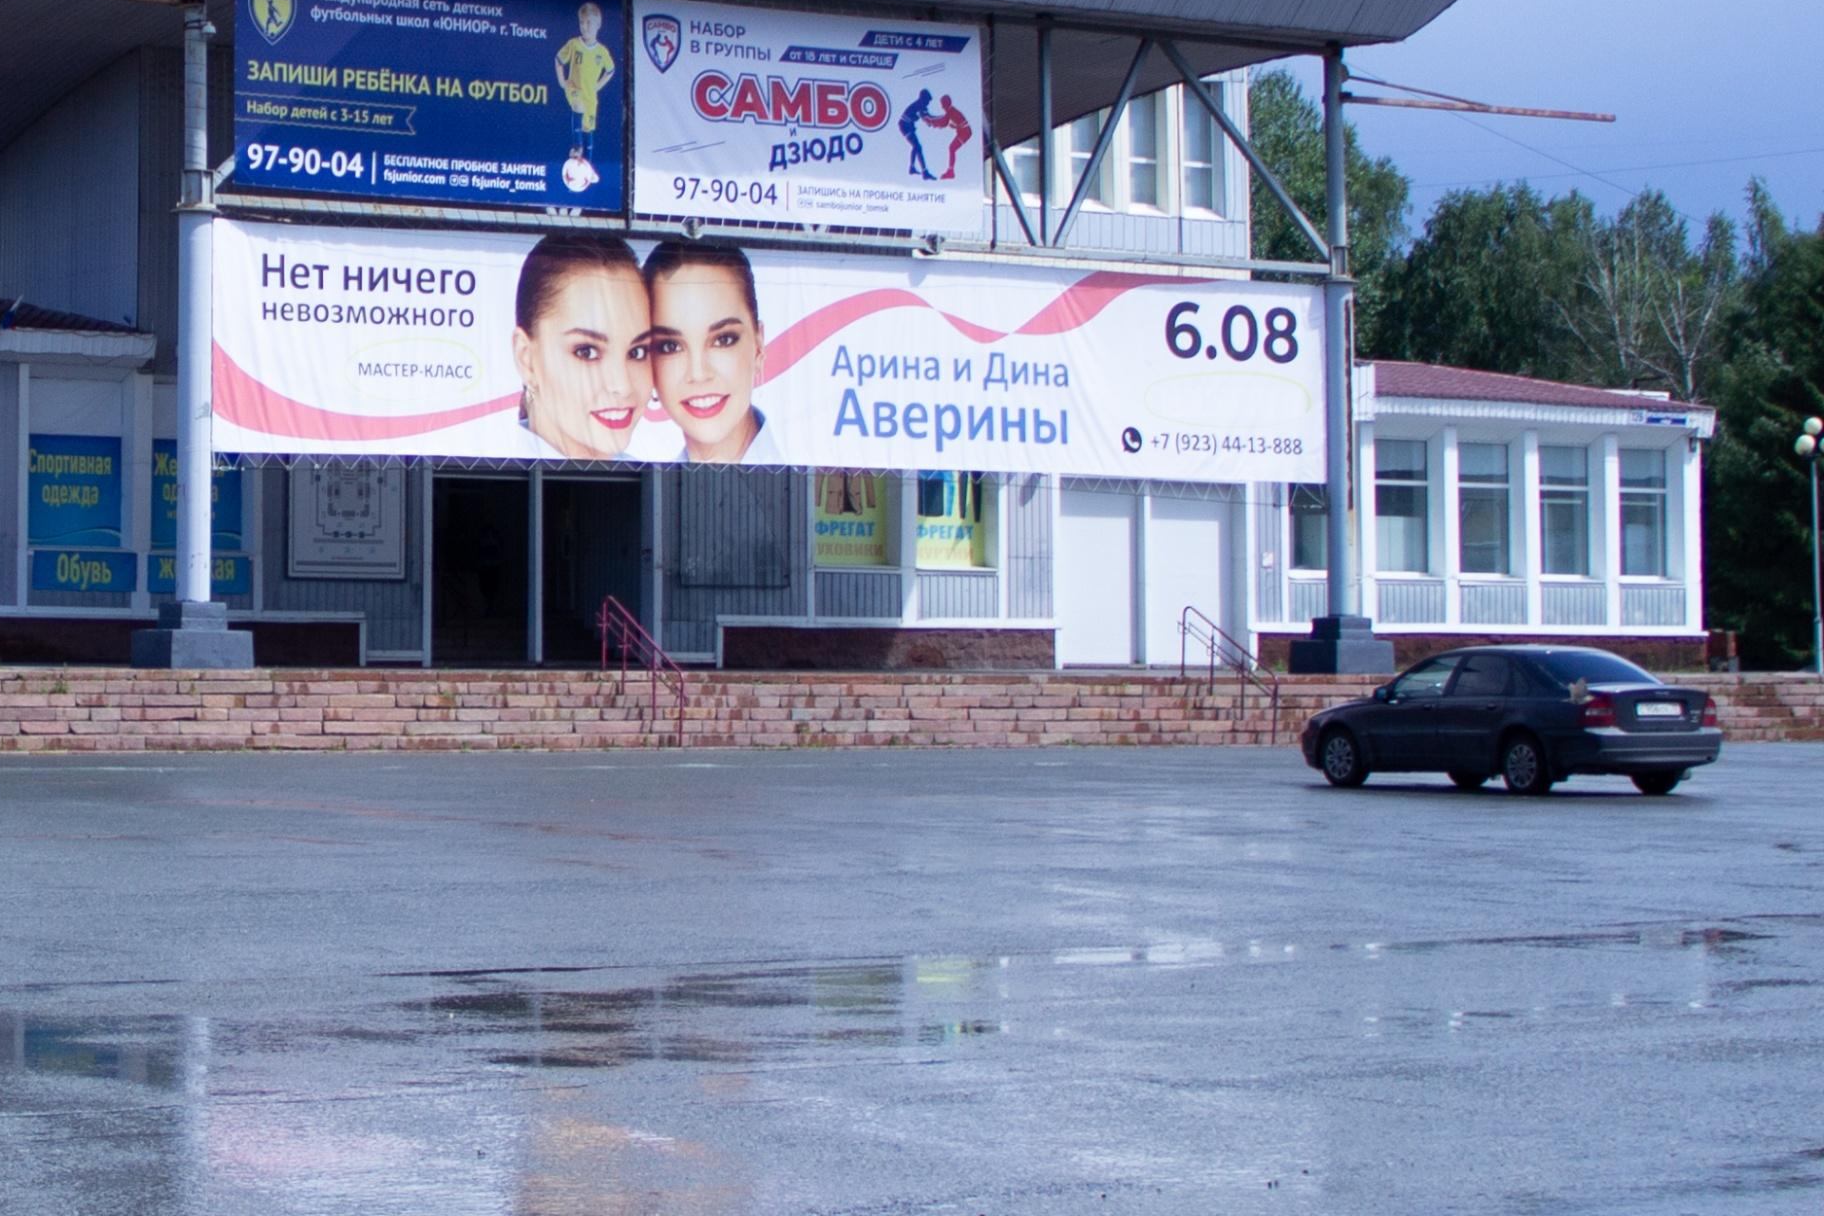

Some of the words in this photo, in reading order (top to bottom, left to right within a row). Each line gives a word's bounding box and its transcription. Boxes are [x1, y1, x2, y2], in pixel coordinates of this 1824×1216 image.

[423, 0, 450, 12] сеть
[452, 2, 503, 17] детских
[310, 6, 392, 26] футбольных
[396, 15, 429, 28] школ
[433, 17, 497, 34] «ЮНИОР»
[500, 25, 509, 36] г.
[510, 23, 547, 39] Томск
[690, 20, 746, 39] НАБОР
[690, 39, 700, 54] В
[705, 41, 771, 62] ГРУППЫ
[873, 34, 903, 46] ДЕТИ
[925, 37, 944, 48] ЛЕТ
[818, 53, 837, 63] ЛЕТ
[849, 53, 893, 67] СТАРШЕ
[247, 60, 337, 88] ЗАПИШИ
[343, 68, 431, 96] РЕБЁНКА
[436, 77, 463, 98] НА
[468, 80, 548, 105] ФУТБОЛ
[246, 100, 288, 118] Набор
[291, 105, 327, 121] детей
[330, 110, 338, 121] с
[340, 108, 369, 124] 3-15
[372, 114, 394, 125] лет
[692, 71, 890, 131] САМБО
[247, 143, 364, 179] 97-90-04
[769, 132, 863, 172] ДЗЮДО
[384, 154, 448, 170] БЕСПЛАТНОЕ
[451, 159, 498, 173] ПРОБНОЕ
[501, 162, 546, 177] ЗАНЯТИЕ
[383, 169, 446, 185] fsjunior.com
[472, 173, 547, 192] fsjunior_tomsk
[673, 176, 778, 205] 97-90-04
[797, 185, 847, 198] ЗАПИШИСЬ
[849, 188, 861, 199] НА
[863, 189, 904, 202] ПРОБНОЕ
[906, 191, 946, 204] ЗАНЯТИЕ
[261, 252, 330, 292] Нет
[342, 263, 477, 296] ничего
[261, 298, 475, 329] невозможного
[1165, 300, 1300, 364] 6.08
[358, 359, 474, 381] МАСТЕР-КЛАСС
[831, 344, 941, 386] Арина
[953, 356, 973, 382] и
[983, 351, 1069, 391] Дина
[832, 387, 1069, 453] Аверины
[1150, 432, 1170, 450] +7
[1175, 432, 1217, 456] (923)
[1222, 435, 1304, 456] 44-13-888
[29, 448, 112, 478] Спортивная
[42, 484, 99, 508] одежда
[815, 520, 876, 537] ФРЕГАТ
[916, 524, 974, 540] ФРЕГАТ
[56, 552, 113, 591] Обувь
